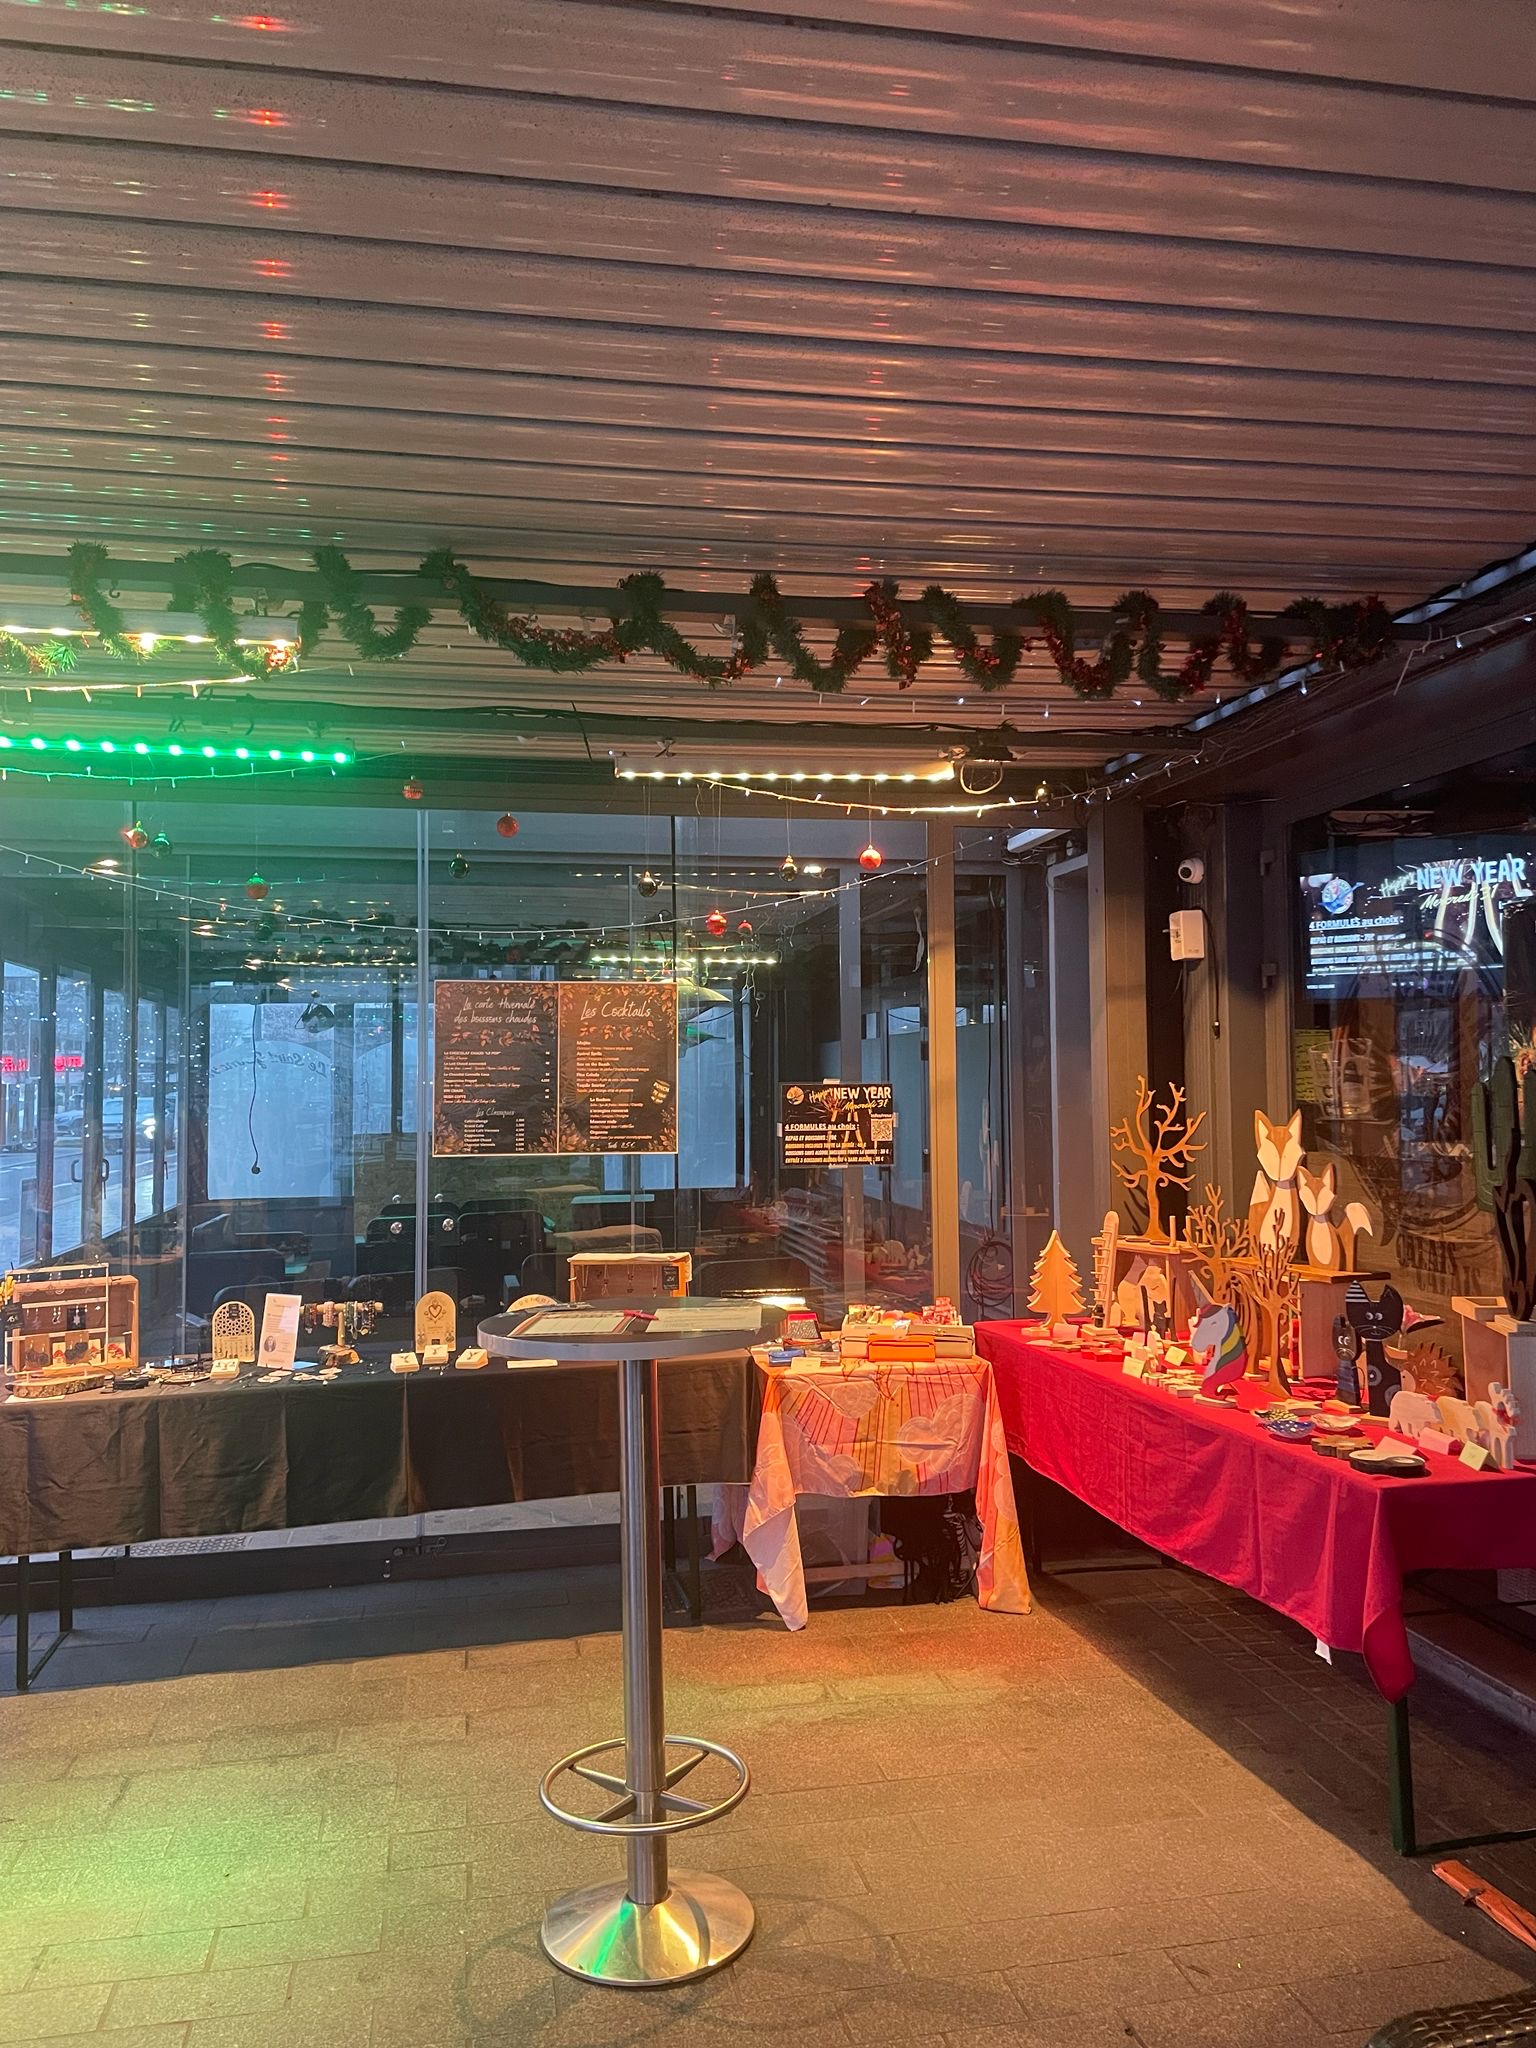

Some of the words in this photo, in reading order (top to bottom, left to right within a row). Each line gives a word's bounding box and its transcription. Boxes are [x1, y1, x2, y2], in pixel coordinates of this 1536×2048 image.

[1416, 863, 1464, 890] NEW
[1471, 857, 1526, 885] YEAR
[1316, 917, 1360, 929] FORMULES
[580, 1000, 597, 1020] Les
[601, 999, 651, 1017] Cocktails
[505, 1010, 537, 1024] chaudes
[834, 1087, 860, 1100] NEW
[863, 1086, 892, 1099] YEAR
